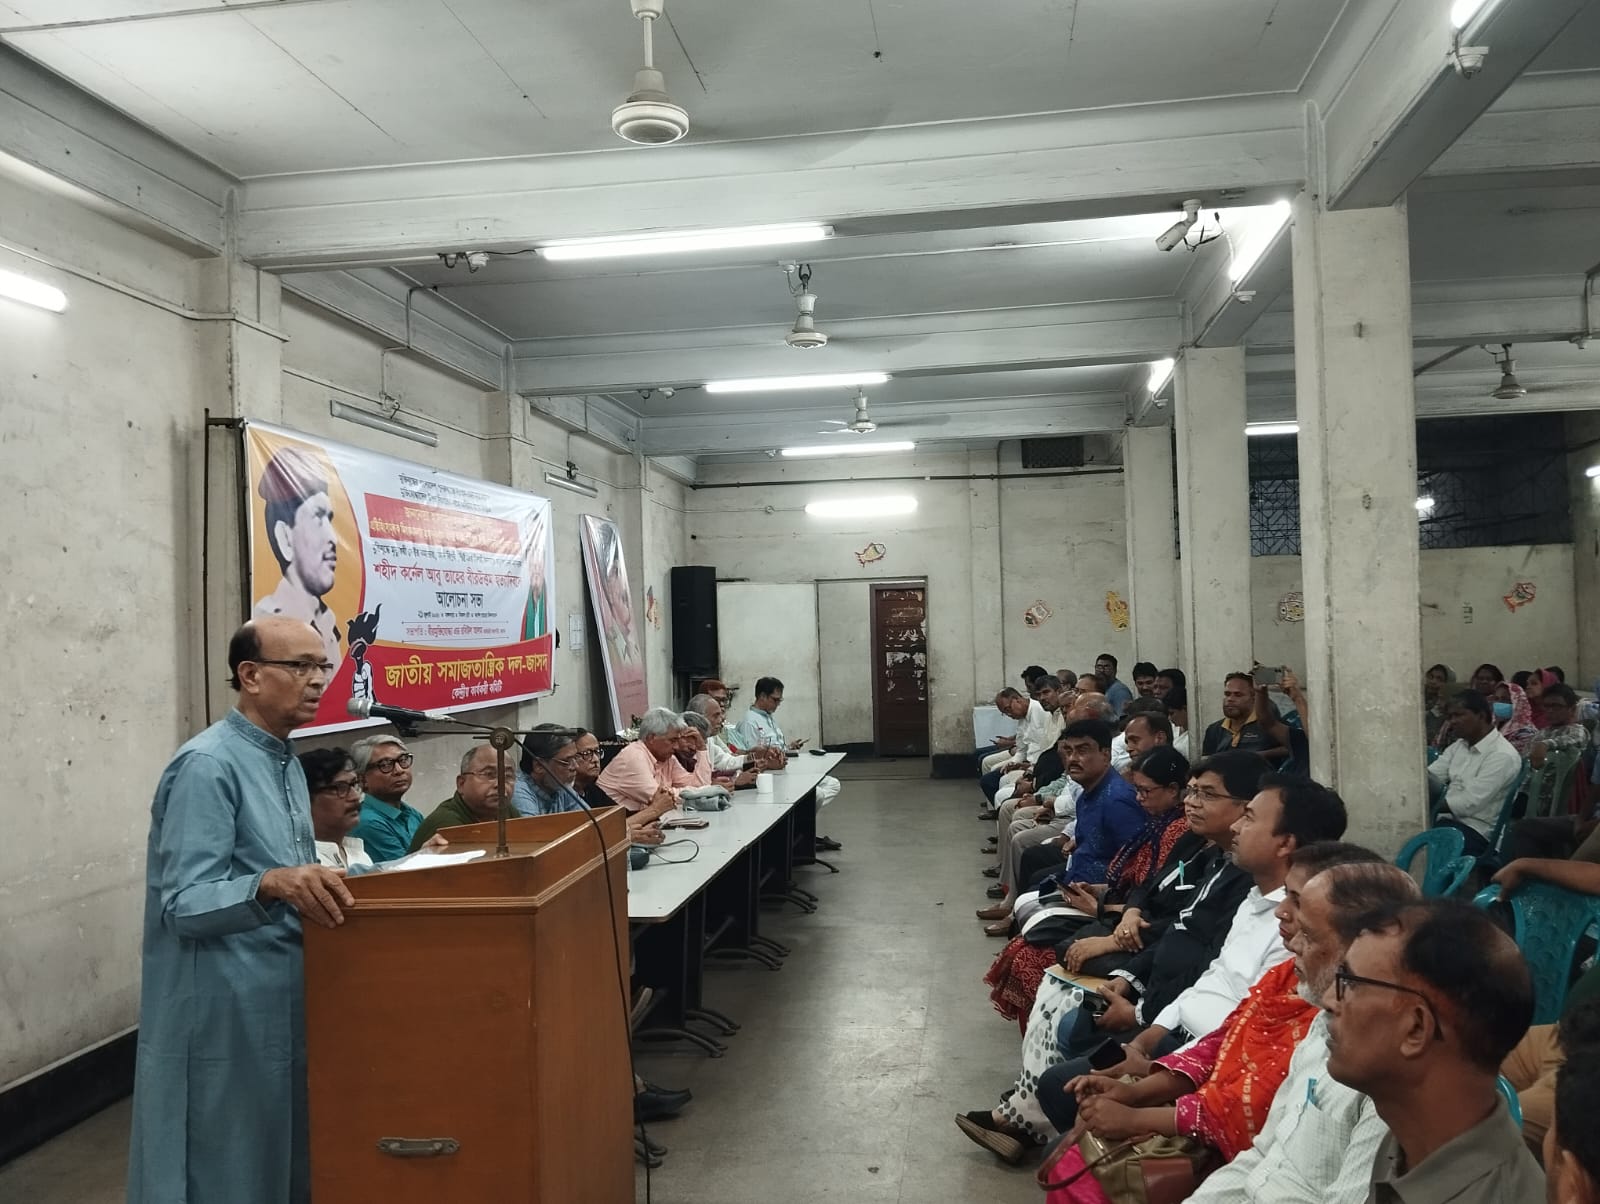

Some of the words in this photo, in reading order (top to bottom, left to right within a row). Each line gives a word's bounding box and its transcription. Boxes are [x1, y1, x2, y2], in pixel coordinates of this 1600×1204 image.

[373, 558, 398, 581] শহীদ
[400, 561, 424, 583] কর্নেল
[426, 567, 442, 587] আবু
[436, 591, 468, 609] আলোচনা
[470, 593, 484, 609] সভা
[384, 654, 434, 688] জাতীয়
[436, 651, 506, 683] সমাজতান্ত্রিক
[507, 653, 549, 676] দল-জাসদ
